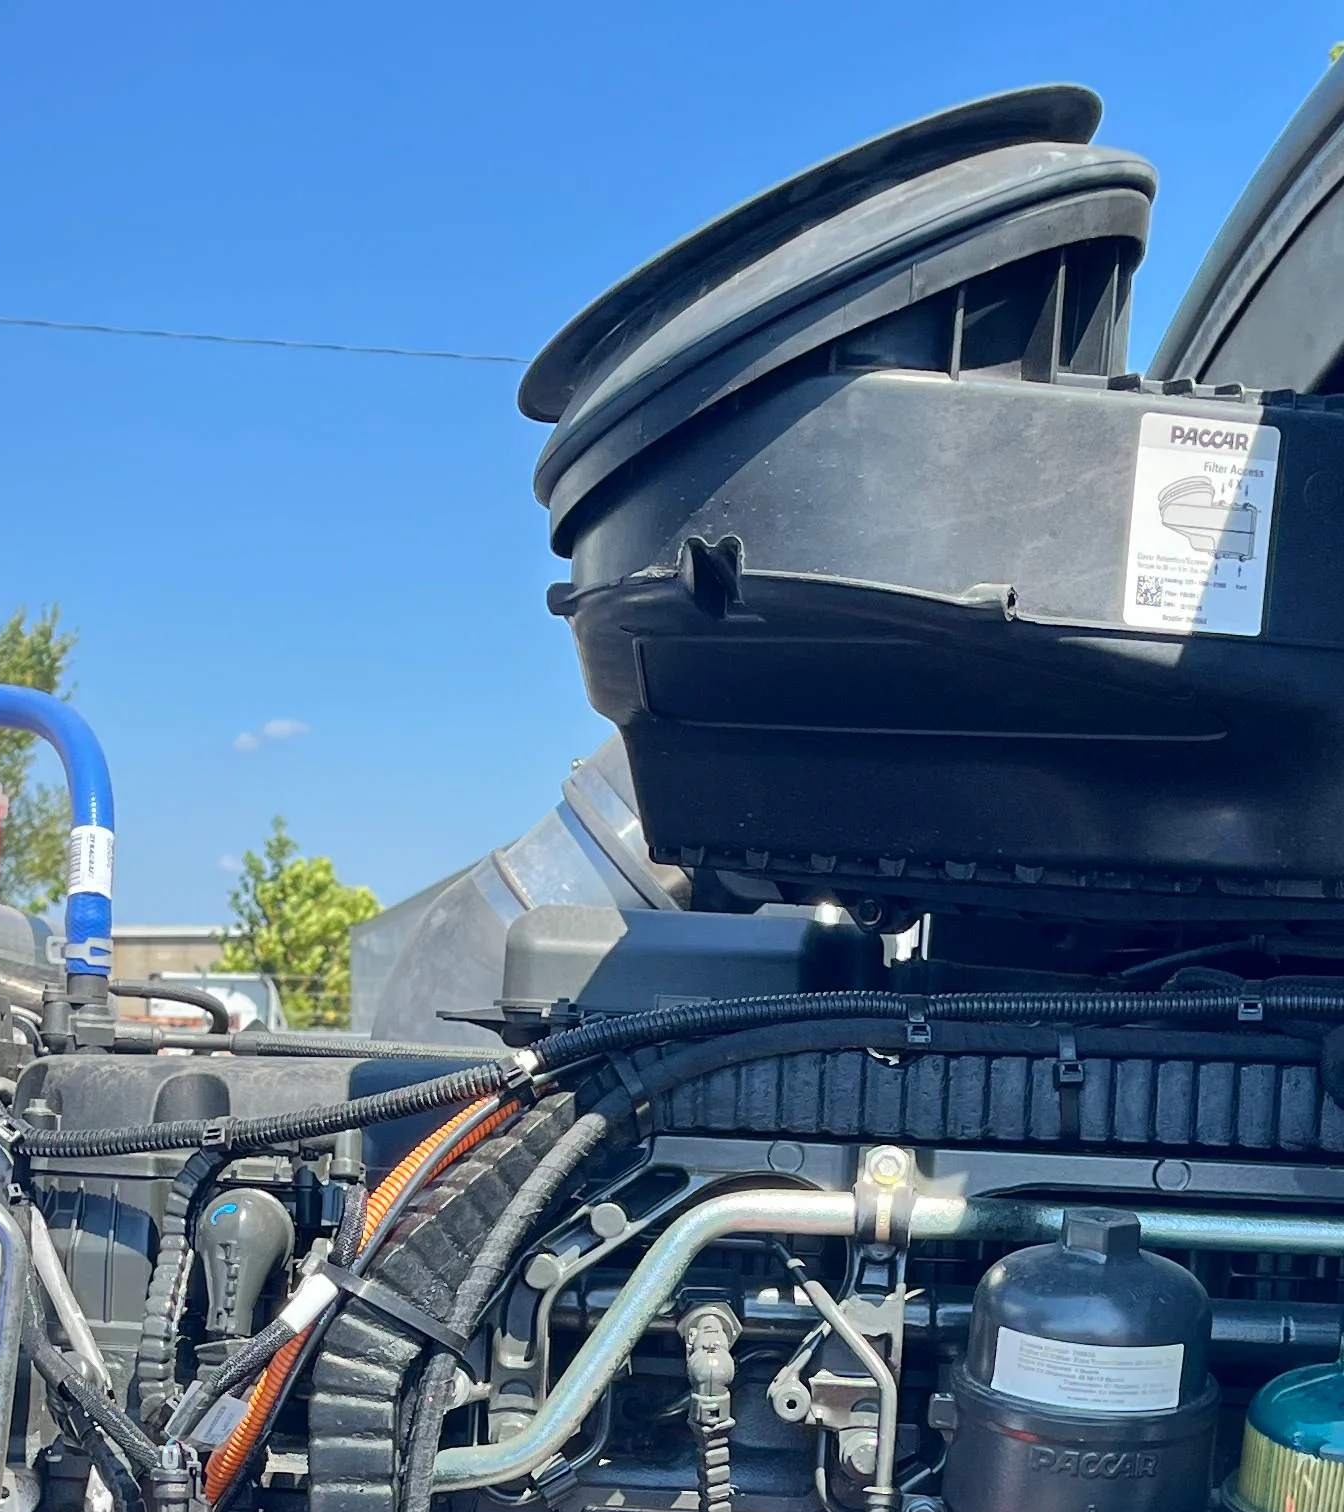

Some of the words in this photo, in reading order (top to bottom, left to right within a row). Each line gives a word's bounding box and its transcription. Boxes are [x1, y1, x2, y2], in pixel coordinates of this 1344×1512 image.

[1170, 425, 1249, 450] PACCAR
[1203, 461, 1228, 474] Filter
[1230, 464, 1264, 477] Access
[1228, 479, 1234, 488] 4
[1236, 479, 1242, 490] X
[1030, 1446, 1159, 1480] PACCAR
